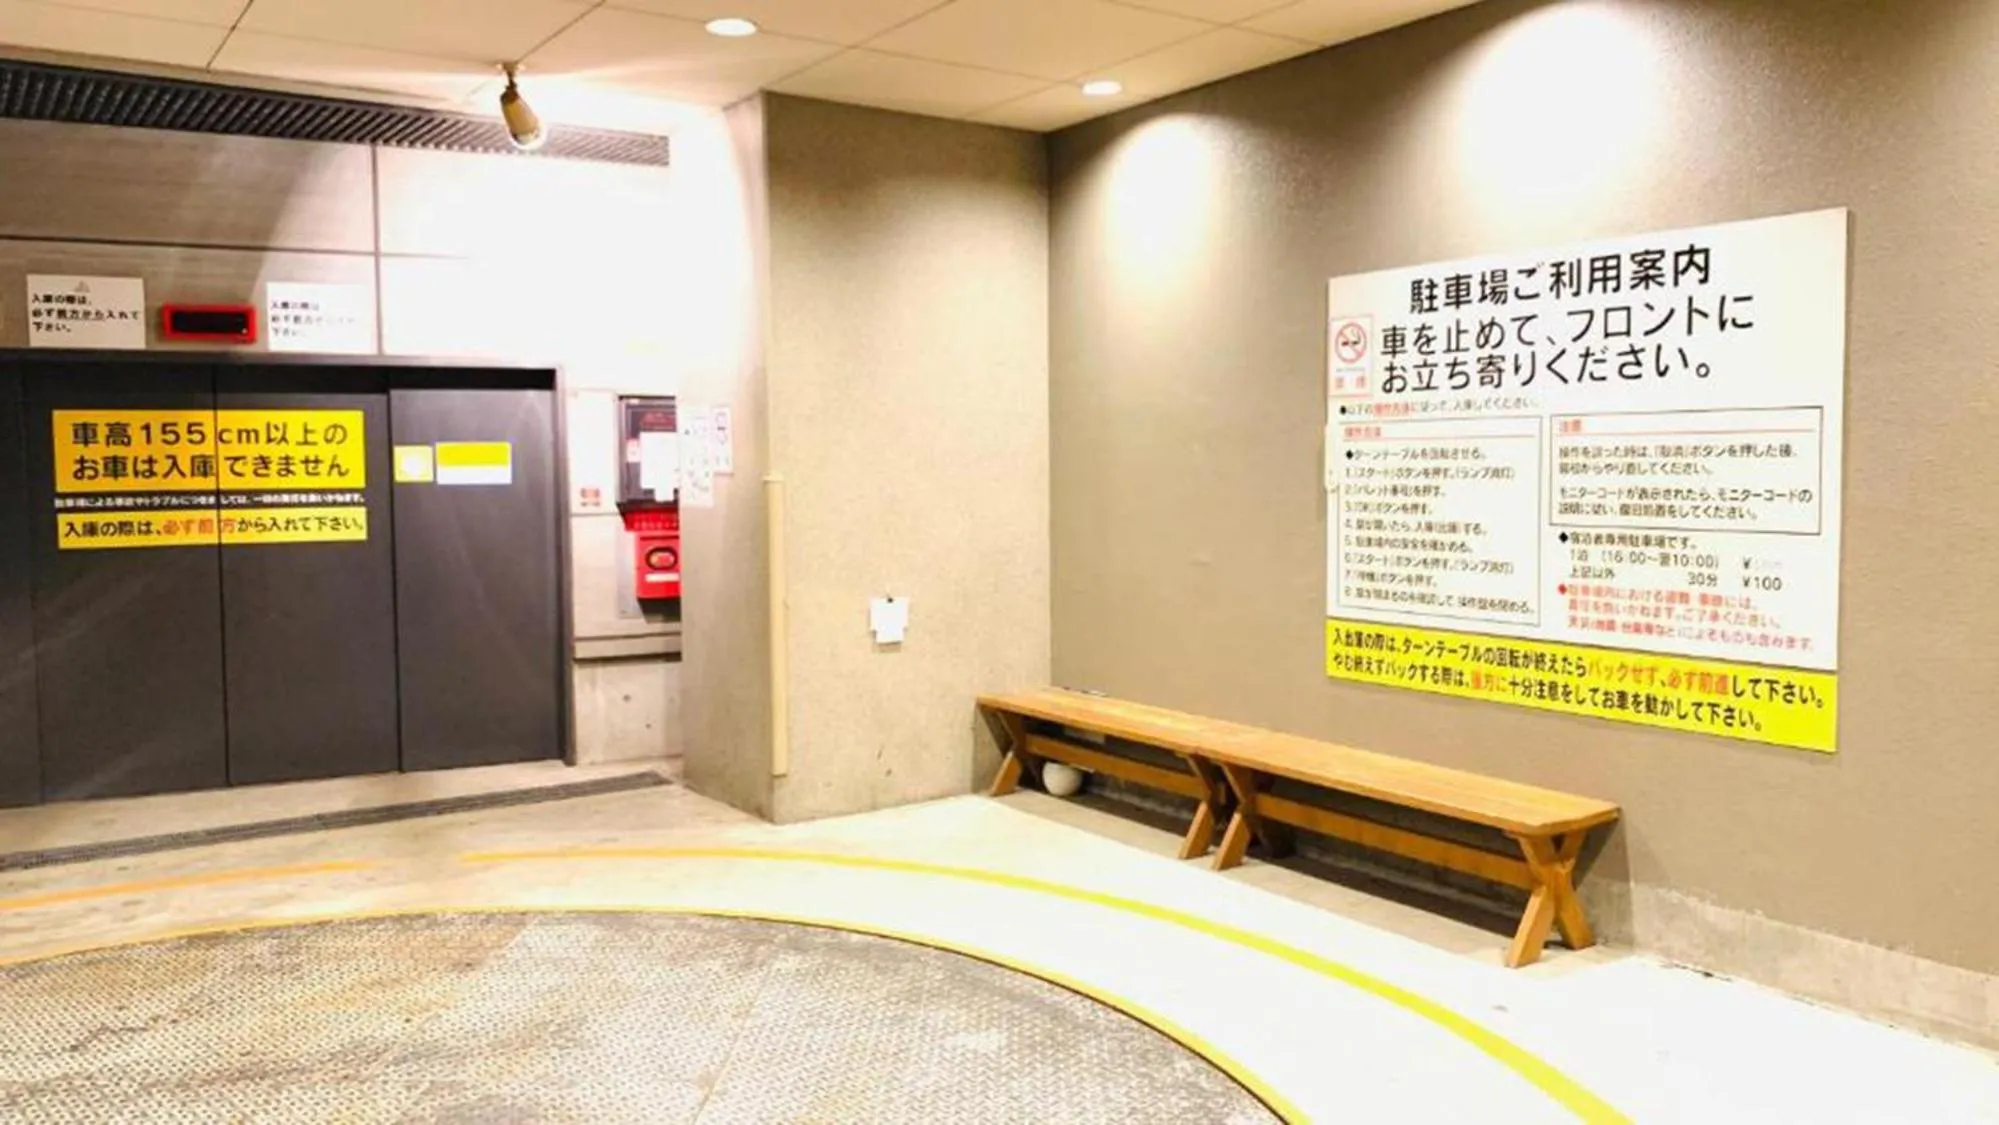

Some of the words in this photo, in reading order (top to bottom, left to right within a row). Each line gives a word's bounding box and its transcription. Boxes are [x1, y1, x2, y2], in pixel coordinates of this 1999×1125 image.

[1409, 244, 1711, 314] 駐車場ご利用案内
[1381, 294, 1754, 360] 車を止めて、フロントに
[1381, 343, 1711, 394] お立ち寄りください。
[71, 422, 348, 447] 車高155cm以上の
[72, 454, 350, 481] お車は入庫できません
[65, 518, 364, 538] 入庫の際は、必ず前方から入れて下さい。
[1742, 575, 1782, 591] ¥100
